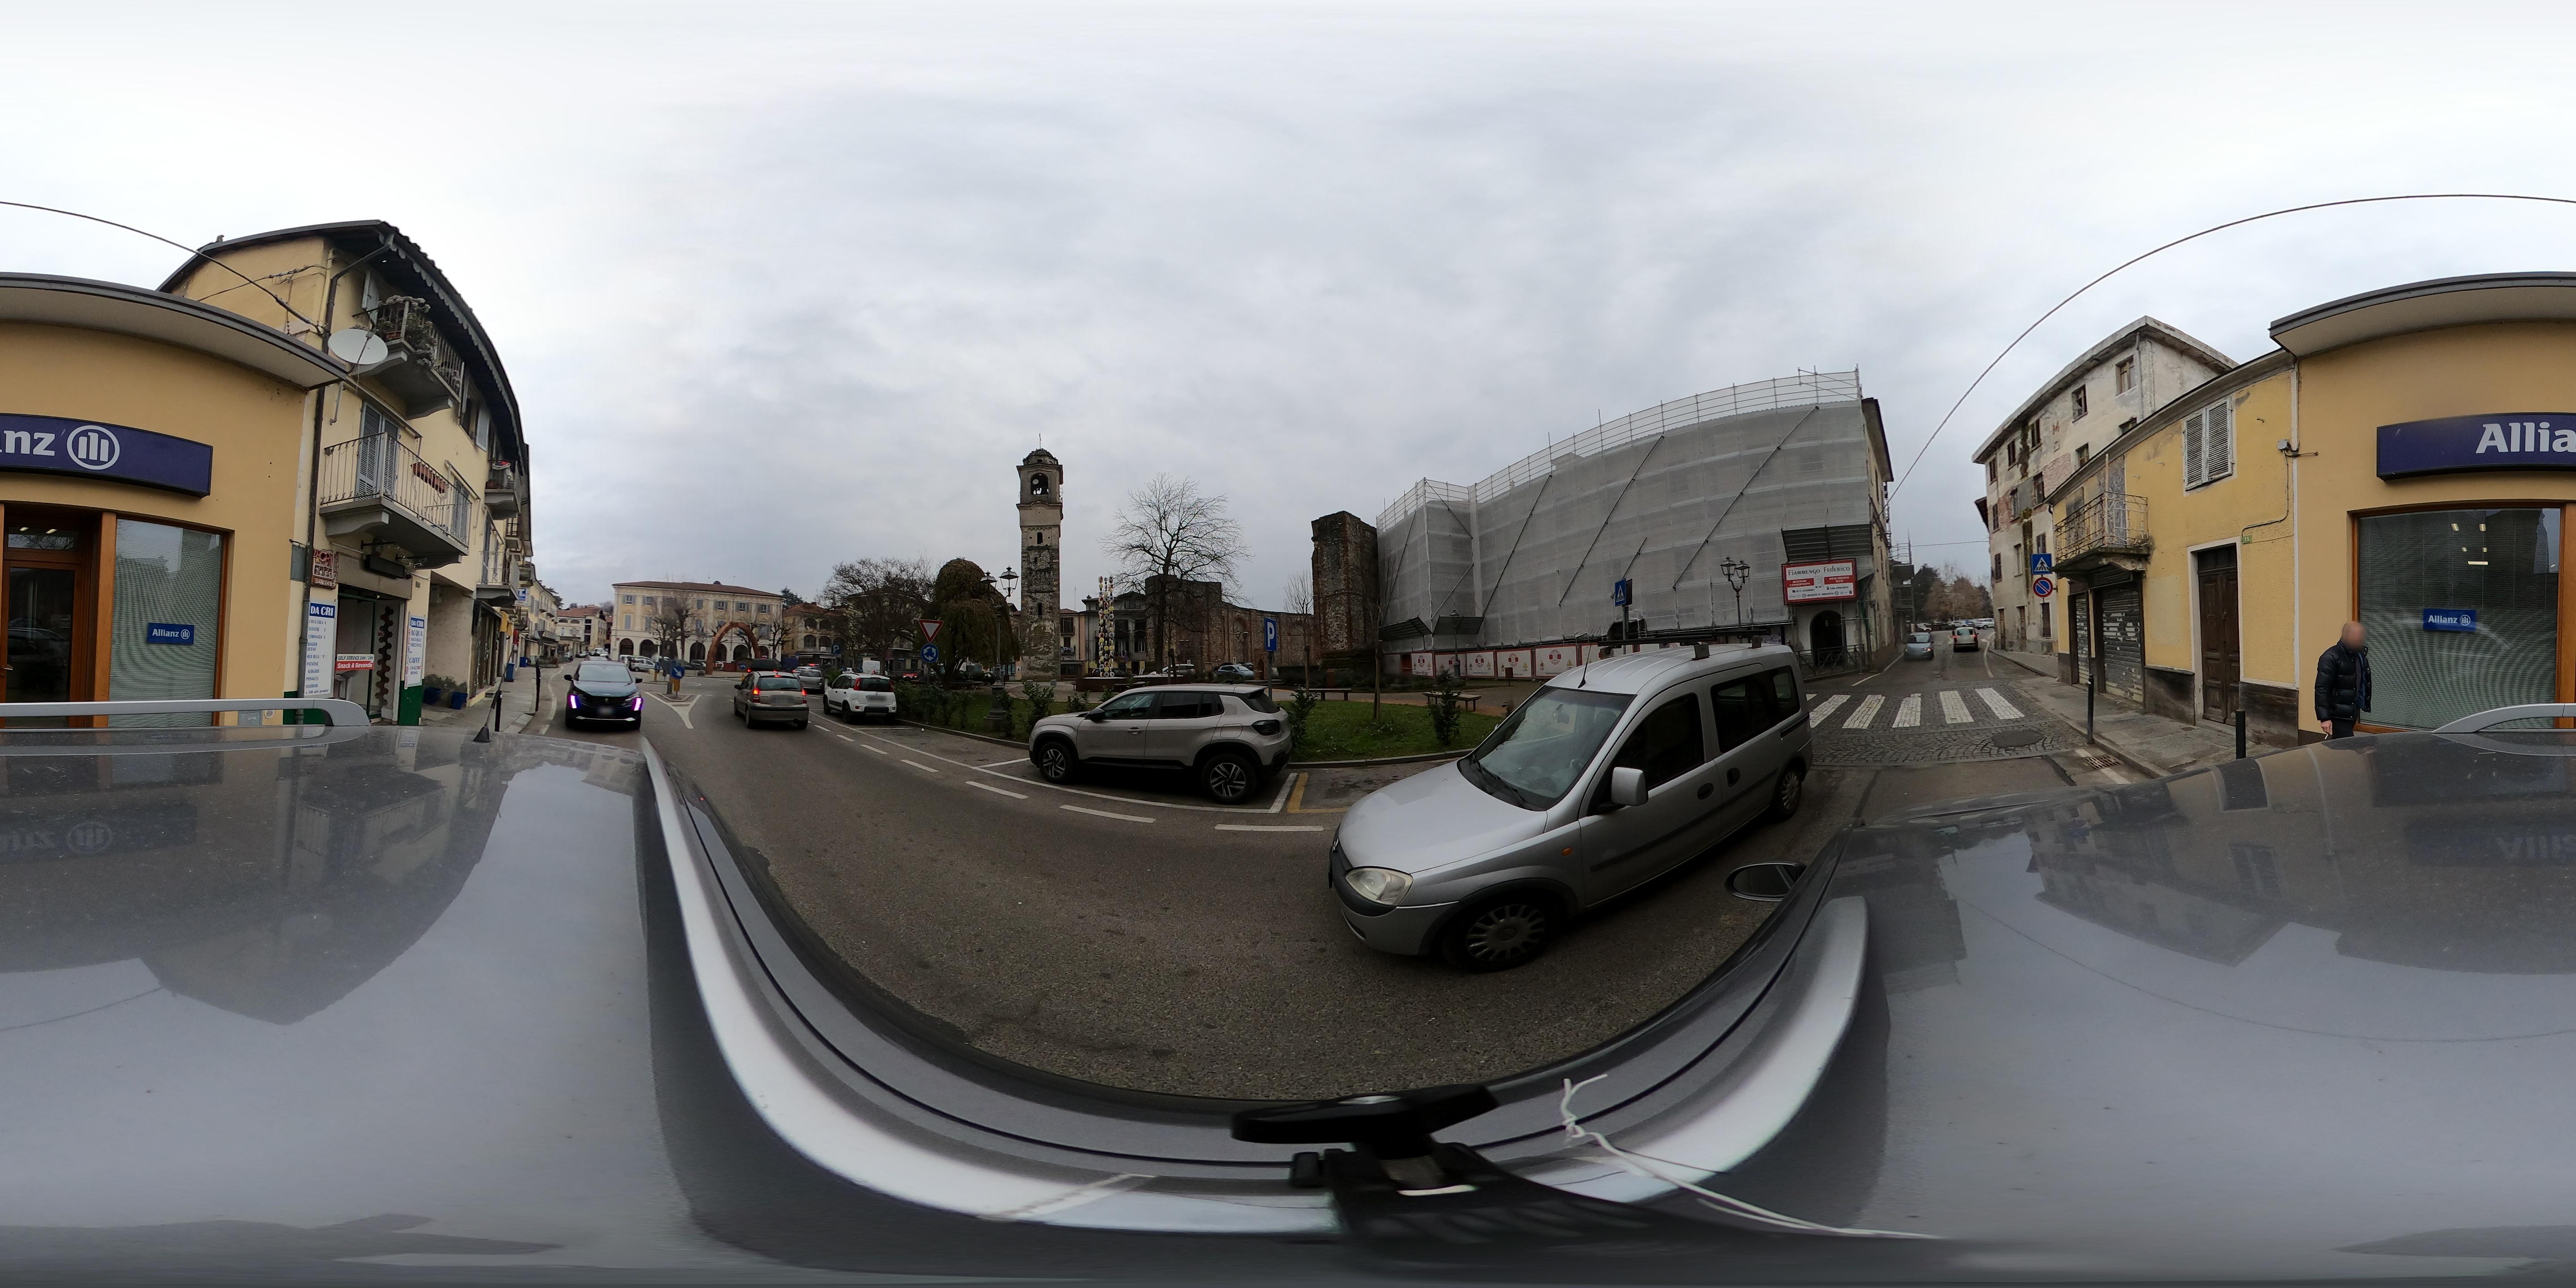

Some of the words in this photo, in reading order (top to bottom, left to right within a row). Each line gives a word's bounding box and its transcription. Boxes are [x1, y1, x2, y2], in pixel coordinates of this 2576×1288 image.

[0, 430, 55, 456] nz
[310, 606, 319, 614] DA
[321, 606, 334, 616] CRI
[2428, 615, 2458, 623] Allianz
[152, 629, 179, 637] Allianz
[1267, 622, 1275, 648] P
[833, 645, 839, 653] P
